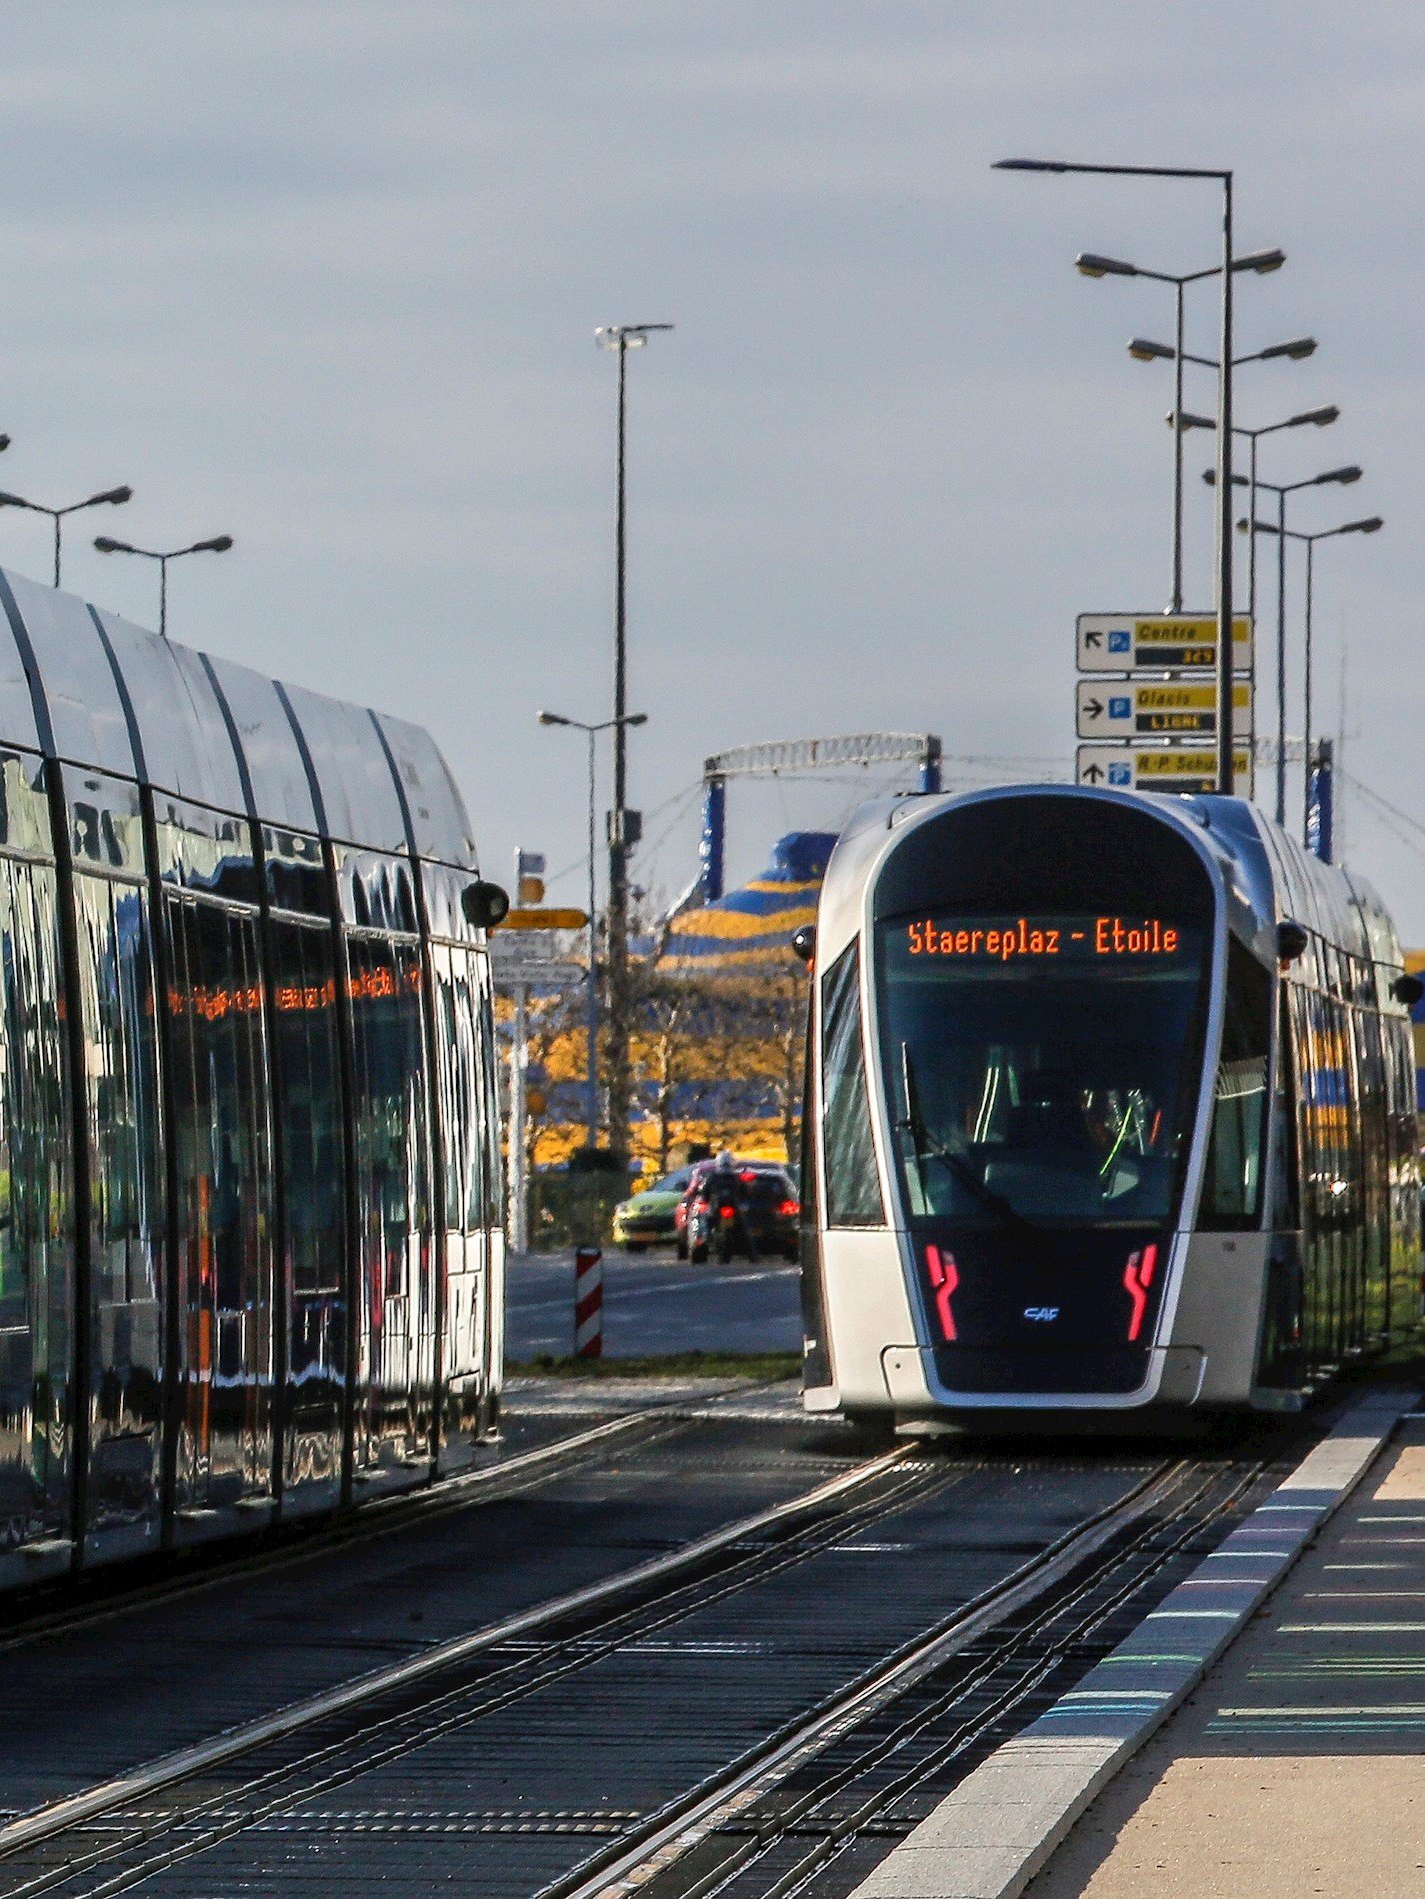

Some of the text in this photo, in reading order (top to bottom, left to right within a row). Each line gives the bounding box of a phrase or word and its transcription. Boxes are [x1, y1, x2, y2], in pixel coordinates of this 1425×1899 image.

[1139, 624, 1198, 640] Centre
[907, 918, 1059, 962] Staereplaz
[1094, 917, 1178, 953] Etoile
[1024, 1307, 1059, 1321] CAF
